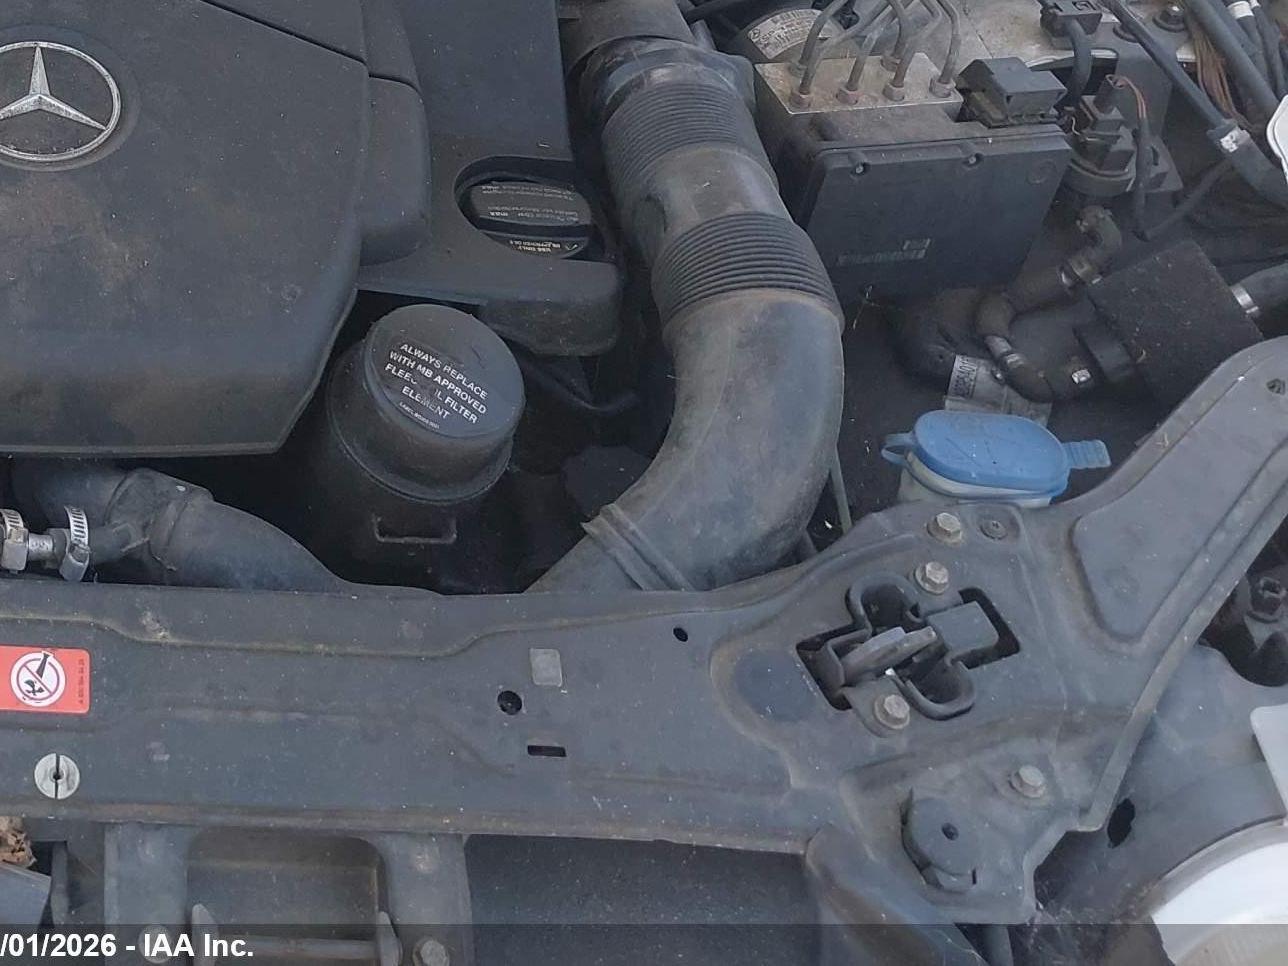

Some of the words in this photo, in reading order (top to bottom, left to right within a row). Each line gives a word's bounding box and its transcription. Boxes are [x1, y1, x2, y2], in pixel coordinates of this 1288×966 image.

[385, 363, 418, 385] FLEE
[444, 396, 478, 424] FILTER
[389, 351, 416, 369] WITH
[416, 364, 433, 378] MB
[433, 375, 487, 414] APPROVED
[400, 344, 442, 369] ALWAYS
[443, 364, 488, 400] REPLACE
